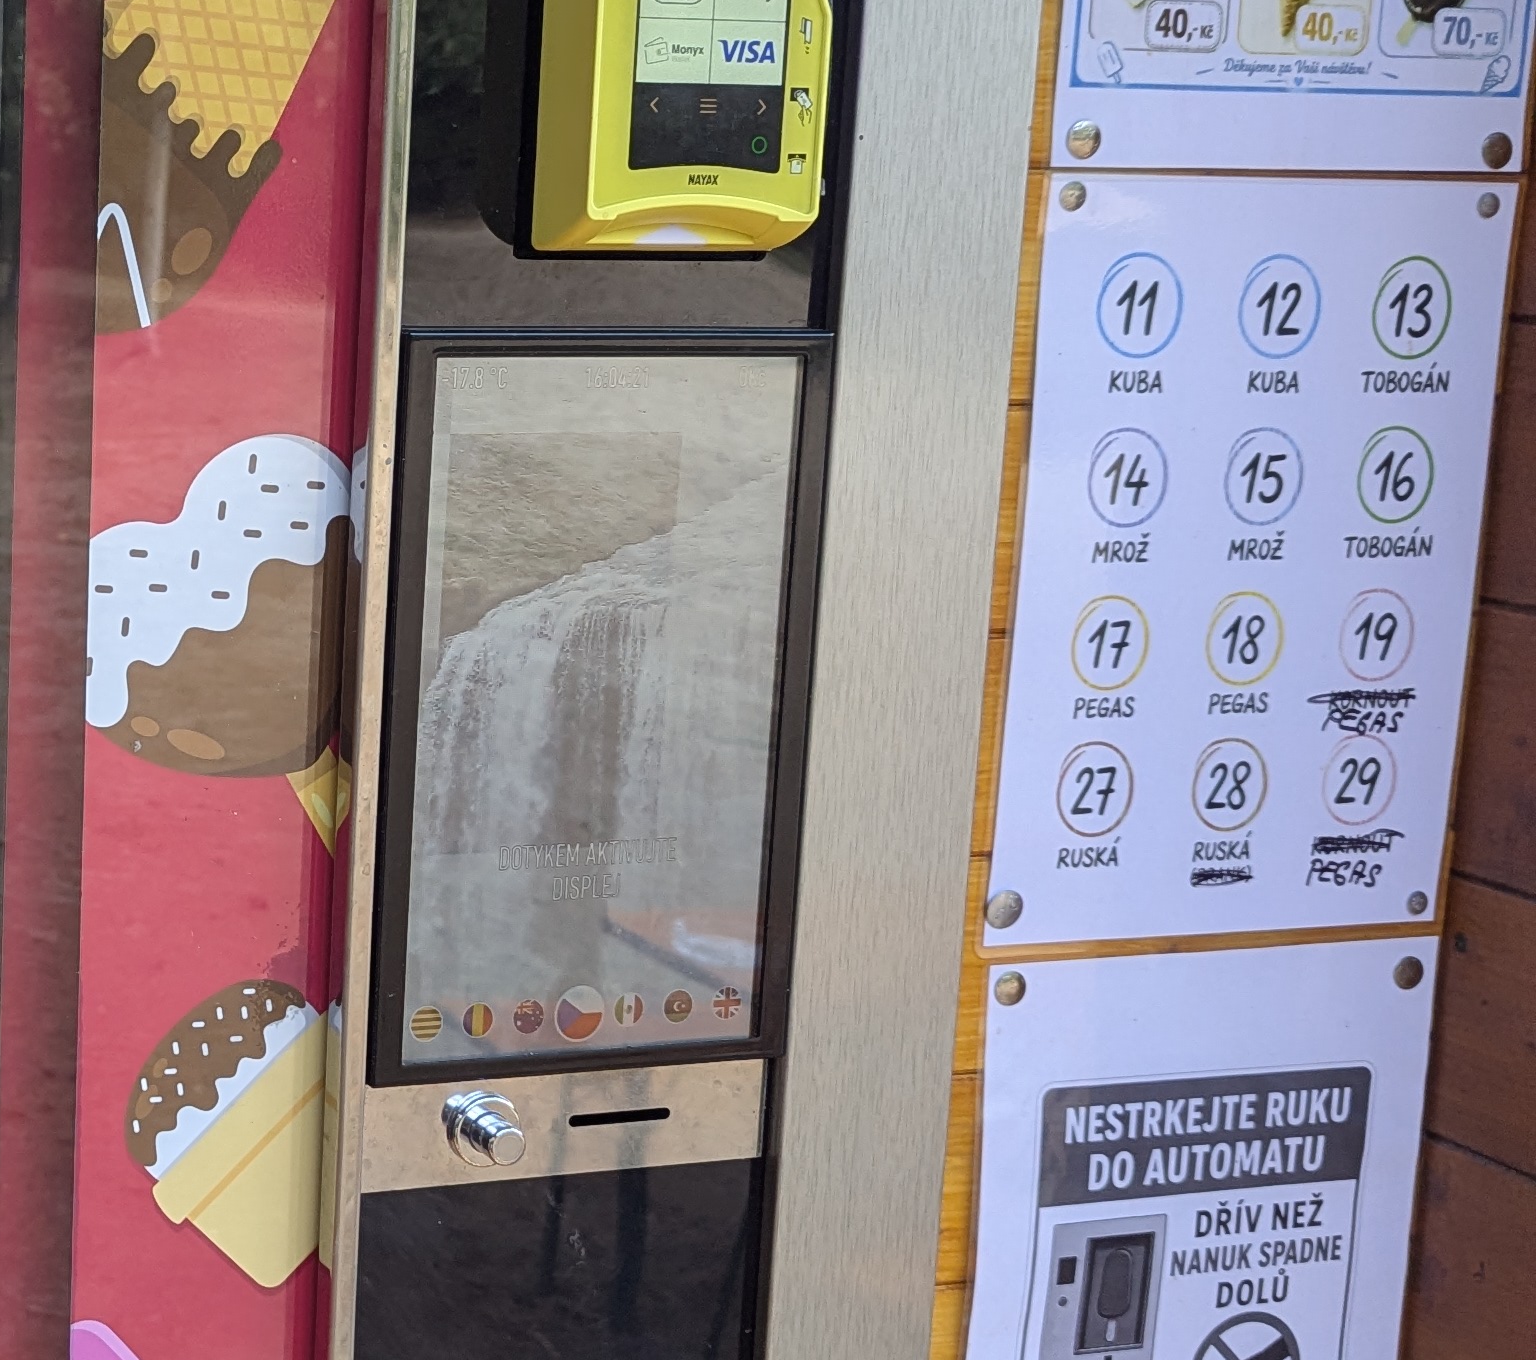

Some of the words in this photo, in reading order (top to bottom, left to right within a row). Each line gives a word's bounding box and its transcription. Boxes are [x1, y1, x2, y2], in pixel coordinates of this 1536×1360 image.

[1155, 8, 1199, 42] 40,-
[1200, 24, 1214, 39] Kč
[1302, 12, 1345, 46] 40,-
[1346, 27, 1359, 43] Kč
[1442, 16, 1483, 47] 70,-
[1485, 30, 1499, 46] Kč
[671, 44, 704, 57] Monyx
[717, 39, 776, 63] VISA
[1223, 57, 1276, 77] Děkujeme
[1277, 63, 1292, 77] za
[1294, 59, 1320, 74] Vaši
[687, 173, 719, 186] NAYAX
[1116, 279, 1159, 336] 11
[1256, 281, 1302, 337] 12
[1388, 282, 1433, 339] 13
[1107, 370, 1164, 394] KUBA
[1246, 370, 1300, 394] KUBA
[1361, 362, 1450, 394] TOBOGÁN
[1103, 452, 1149, 507] 14
[1240, 451, 1287, 504] 15
[1374, 450, 1416, 503] 16
[1091, 532, 1150, 564] MROŽ
[1227, 530, 1286, 561] MROŽ
[1344, 527, 1433, 558] TOBOGÁN
[1088, 619, 1131, 670] 17
[1222, 614, 1266, 665] 18
[1354, 611, 1398, 662] 19
[1072, 697, 1136, 719] PEGAS
[1207, 692, 1270, 715] PEGAS
[1321, 708, 1404, 736] PEGAS
[1070, 767, 1116, 816] 27
[1205, 761, 1251, 811] 28
[1334, 757, 1381, 806] 29
[498, 842, 580, 871] DOTYKEM
[1057, 837, 1122, 869] RUSKÁ
[1192, 830, 1254, 862] RUSKÁ
[552, 873, 621, 902] DISPLEJ
[1305, 857, 1383, 888] PEGAS
[1064, 1094, 1258, 1145] NESTRKEJTE
[1264, 1086, 1352, 1127] RUKU
[1087, 1150, 1135, 1191] DO
[1142, 1135, 1326, 1187] AUTOMATU
[1194, 1199, 1263, 1238] DŘÍV
[1270, 1192, 1325, 1230] NEŽ
[1169, 1242, 1253, 1277] NANUK
[1258, 1235, 1343, 1268] SPADNE
[1215, 1268, 1290, 1308] DOLŮ
